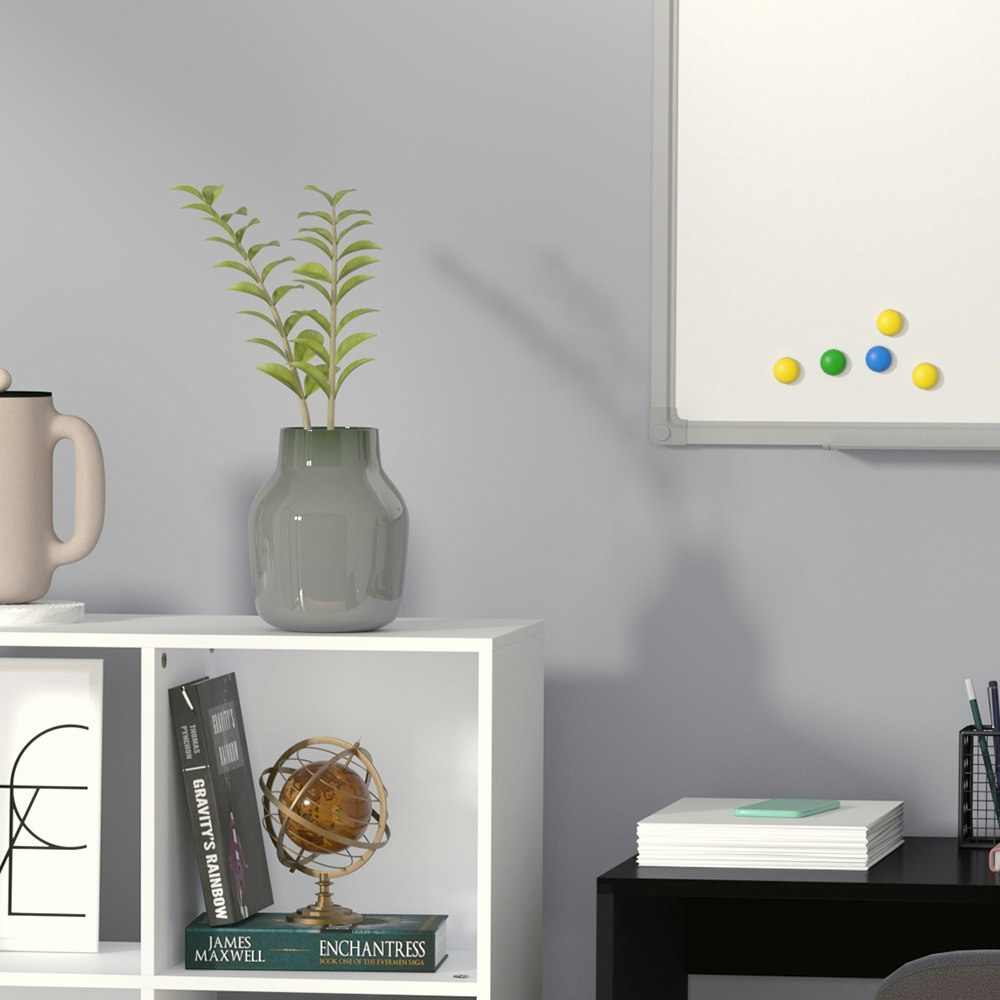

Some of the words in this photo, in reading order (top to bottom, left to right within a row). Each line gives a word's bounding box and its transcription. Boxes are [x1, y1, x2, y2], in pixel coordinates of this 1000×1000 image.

[181, 725, 193, 760] PYNCHON
[189, 724, 201, 754] THOMAS
[192, 778, 216, 851] GRAVITY'S
[205, 853, 228, 919] RAINBOW
[208, 935, 252, 951] JAMES
[319, 939, 426, 958] ENCHANTRESS
[194, 949, 266, 962] MAXWELL
[363, 958, 377, 966] THE
